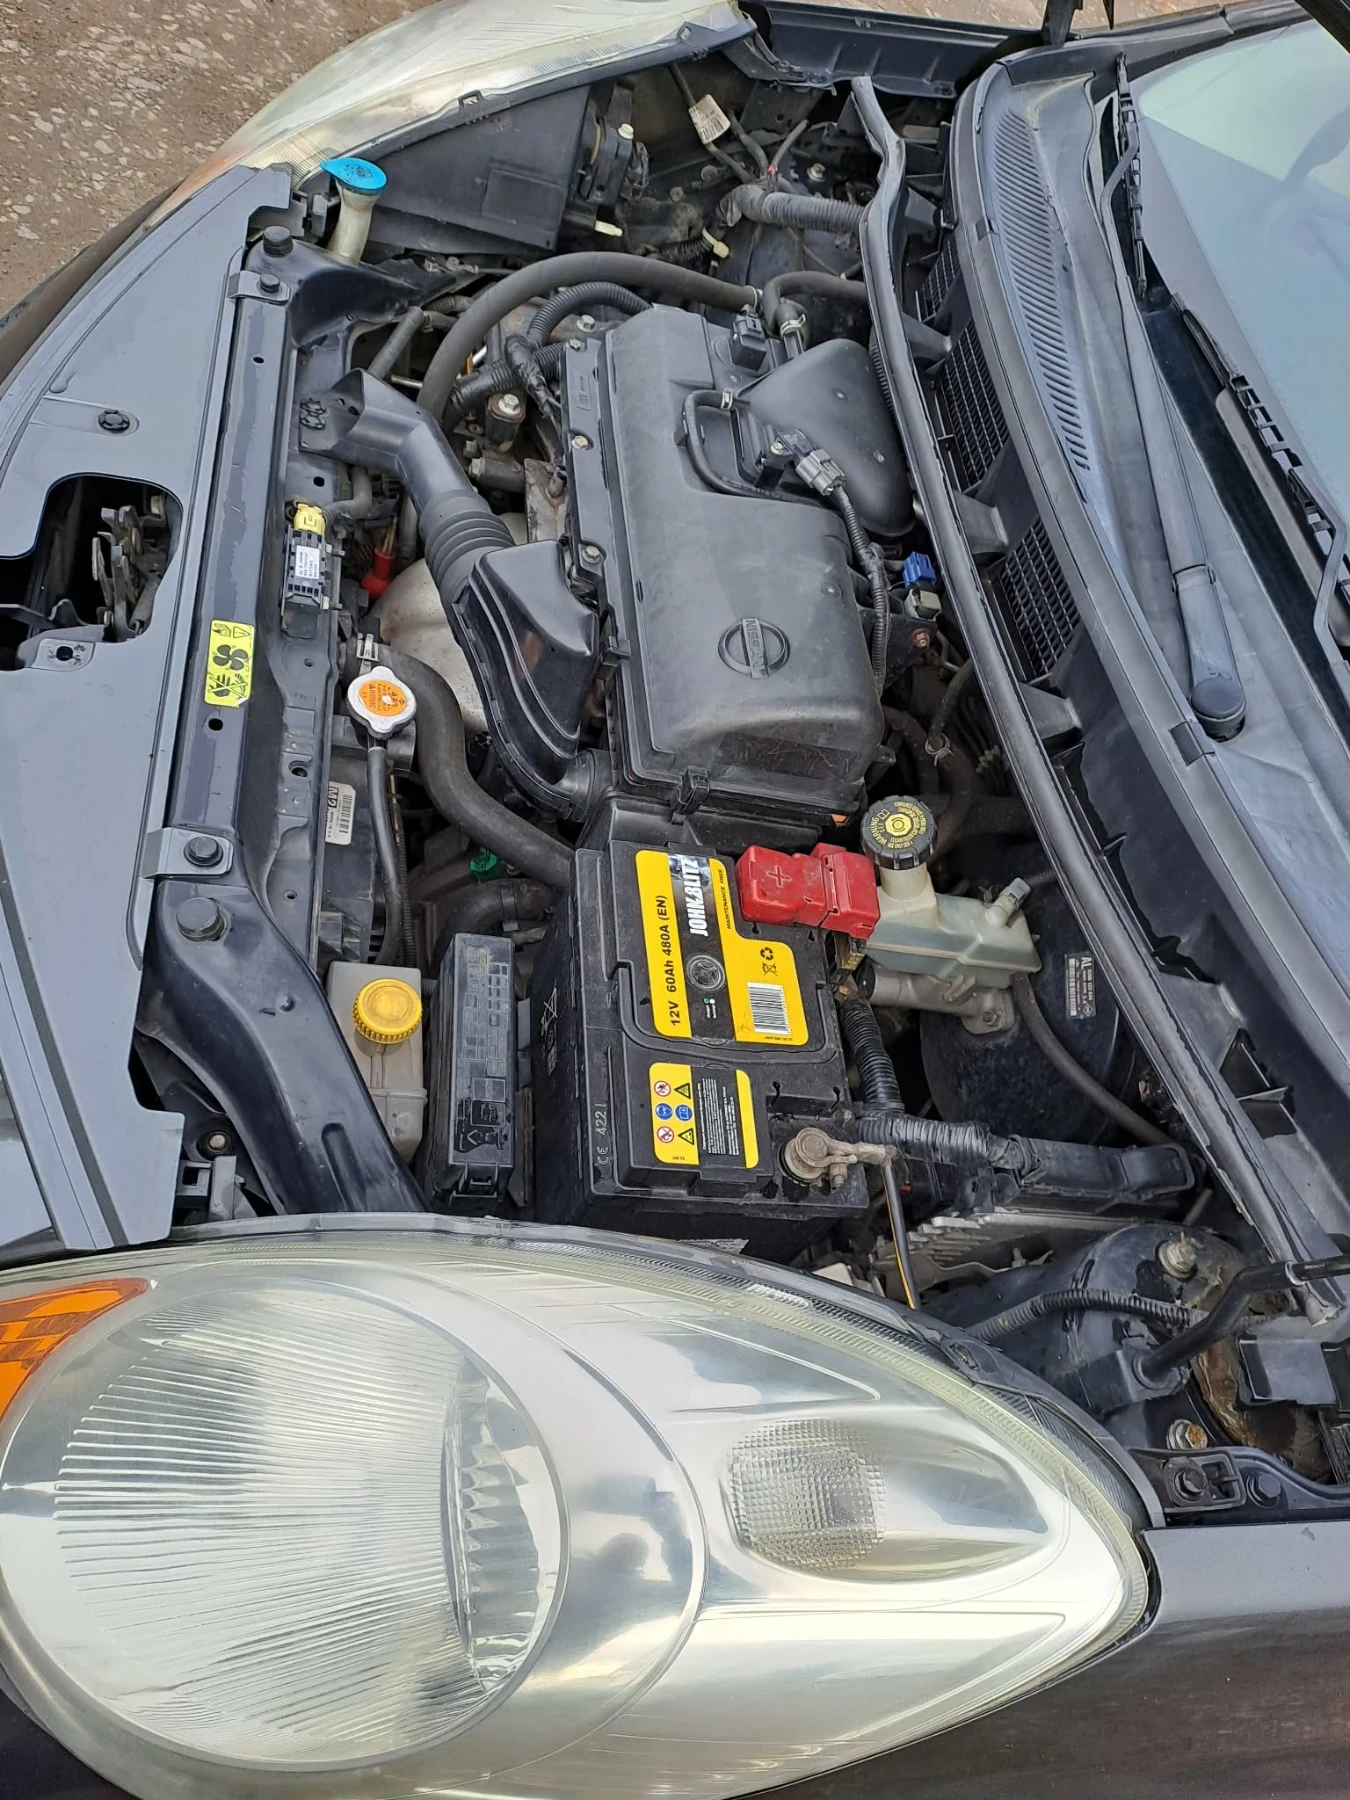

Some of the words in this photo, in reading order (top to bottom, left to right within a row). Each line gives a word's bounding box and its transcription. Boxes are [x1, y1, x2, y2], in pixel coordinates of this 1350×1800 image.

[745, 620, 765, 670] NISSAN
[870, 816, 888, 846] WARNING
[656, 895, 670, 921] (EN)
[721, 886, 731, 930] MAINTENANCE
[660, 924, 672, 957] 480A
[664, 960, 677, 993] 60Ah
[1081, 957, 1092, 970] AL
[671, 1001, 681, 1026] 12V
